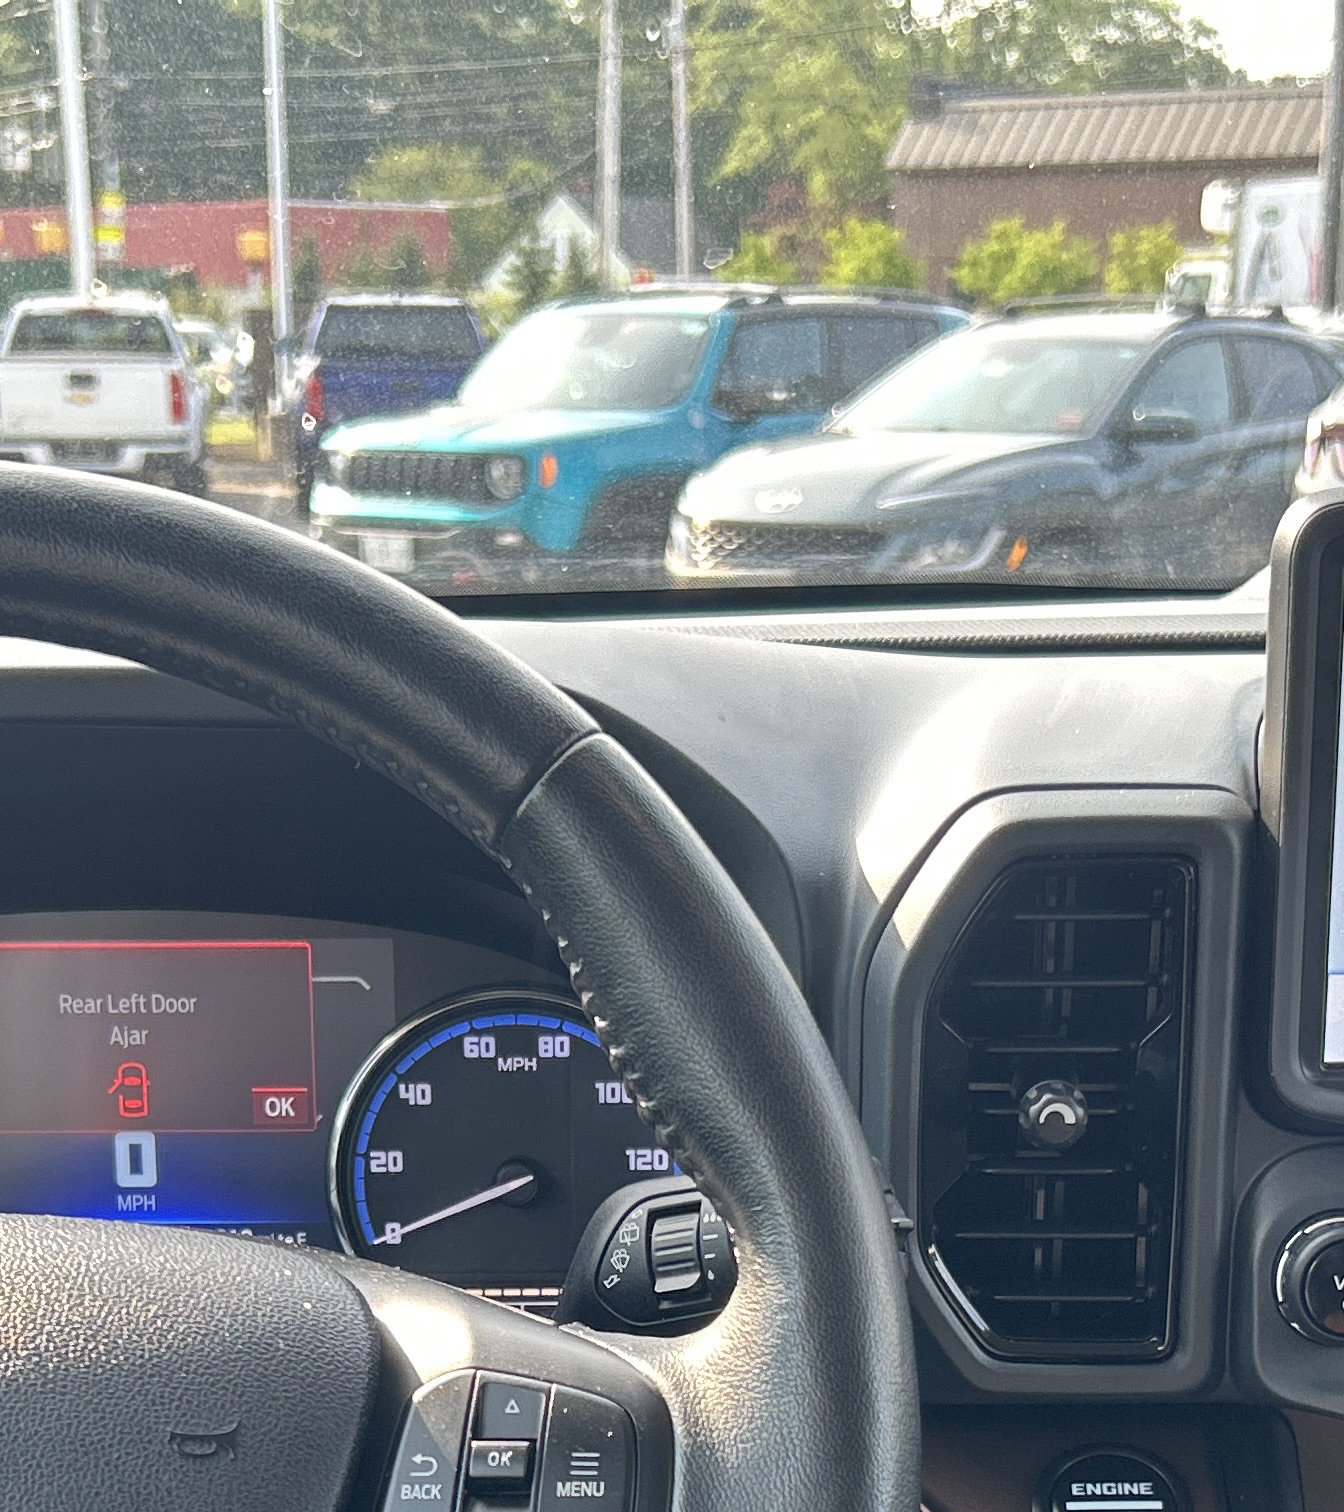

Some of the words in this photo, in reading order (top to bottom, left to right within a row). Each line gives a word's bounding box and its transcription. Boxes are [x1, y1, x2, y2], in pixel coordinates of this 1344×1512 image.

[59, 994, 103, 1013] Rear
[108, 993, 146, 1013] Left
[152, 994, 196, 1013] Door
[110, 1026, 148, 1048] Ajar
[464, 1036, 495, 1058] 60
[539, 1036, 570, 1057] 80
[498, 1057, 537, 1071] MPH
[399, 1084, 431, 1105] 40
[265, 1097, 294, 1116] OK
[112, 1131, 157, 1187] 0
[370, 1151, 403, 1172] 20
[626, 1149, 668, 1170] 120
[118, 1194, 156, 1211] MPH
[488, 1451, 512, 1466] OK
[401, 1484, 441, 1499] BACK
[557, 1481, 604, 1497] MENU
[1072, 1483, 1153, 1495] ENGINE
